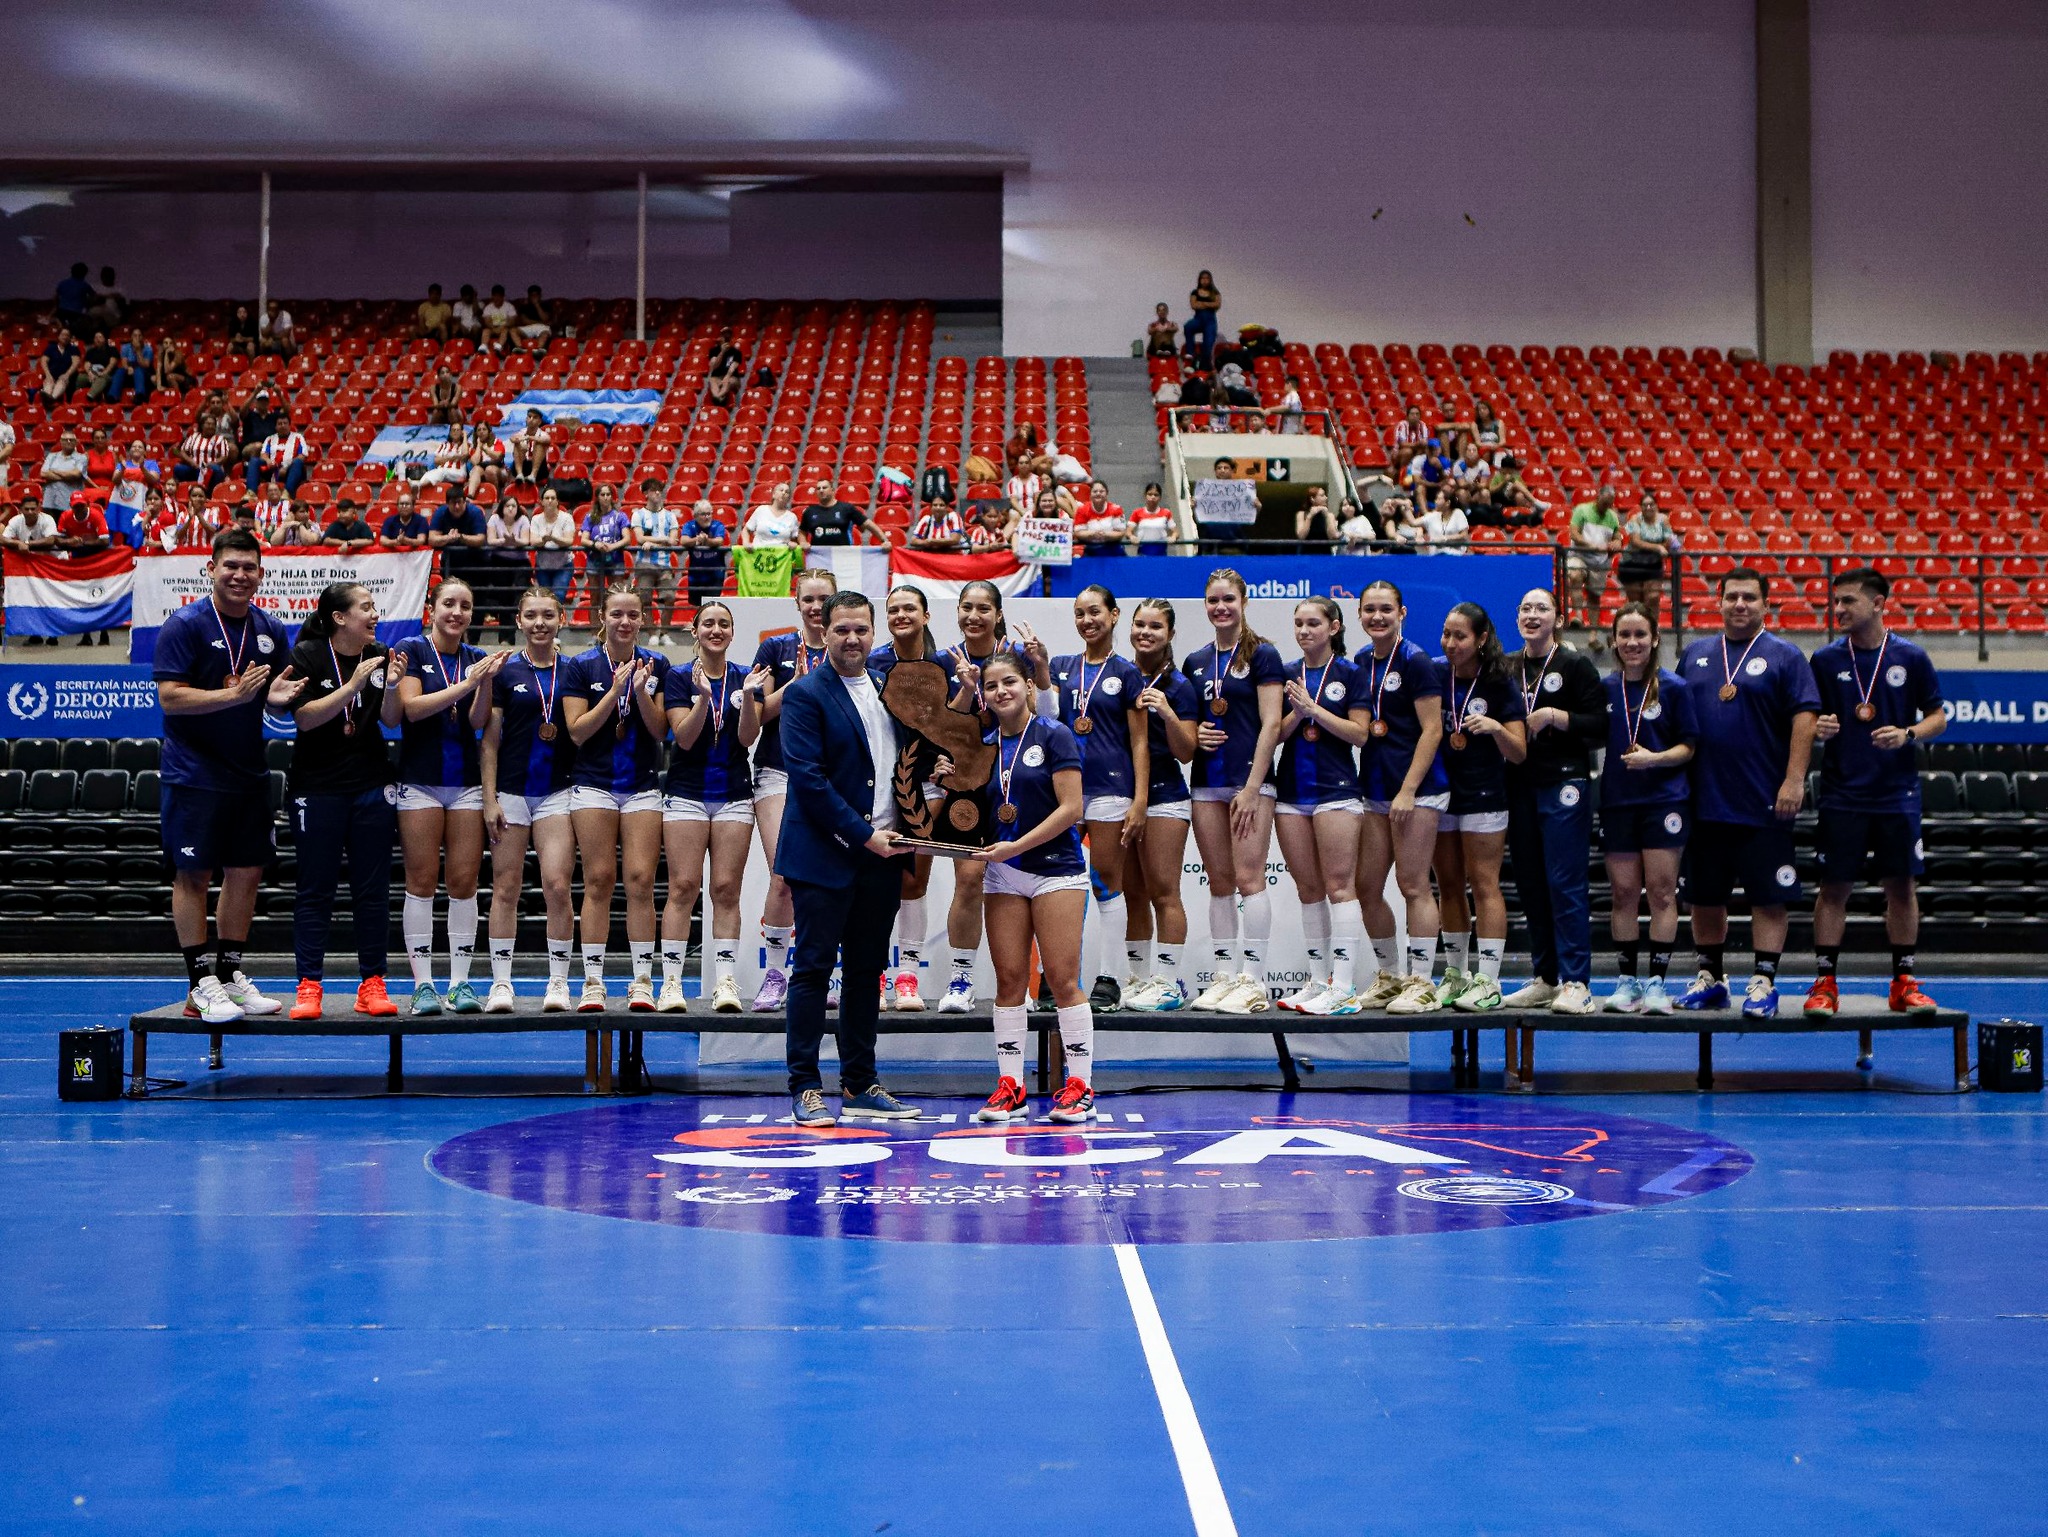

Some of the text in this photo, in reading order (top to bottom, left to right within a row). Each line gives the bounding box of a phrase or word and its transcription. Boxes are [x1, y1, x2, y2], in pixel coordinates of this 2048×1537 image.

[281, 569, 307, 579] HIJA
[311, 568, 326, 579] DE
[330, 569, 357, 579] DIOS
[1246, 579, 1310, 598] ndball
[292, 611, 310, 619] TOD
[55, 679, 159, 691] SECRETARÍA NACIO
[55, 692, 154, 709] DEPORTES
[53, 710, 113, 720] PARAGUAY
[819, 1189, 1138, 1199] DEPORTES
